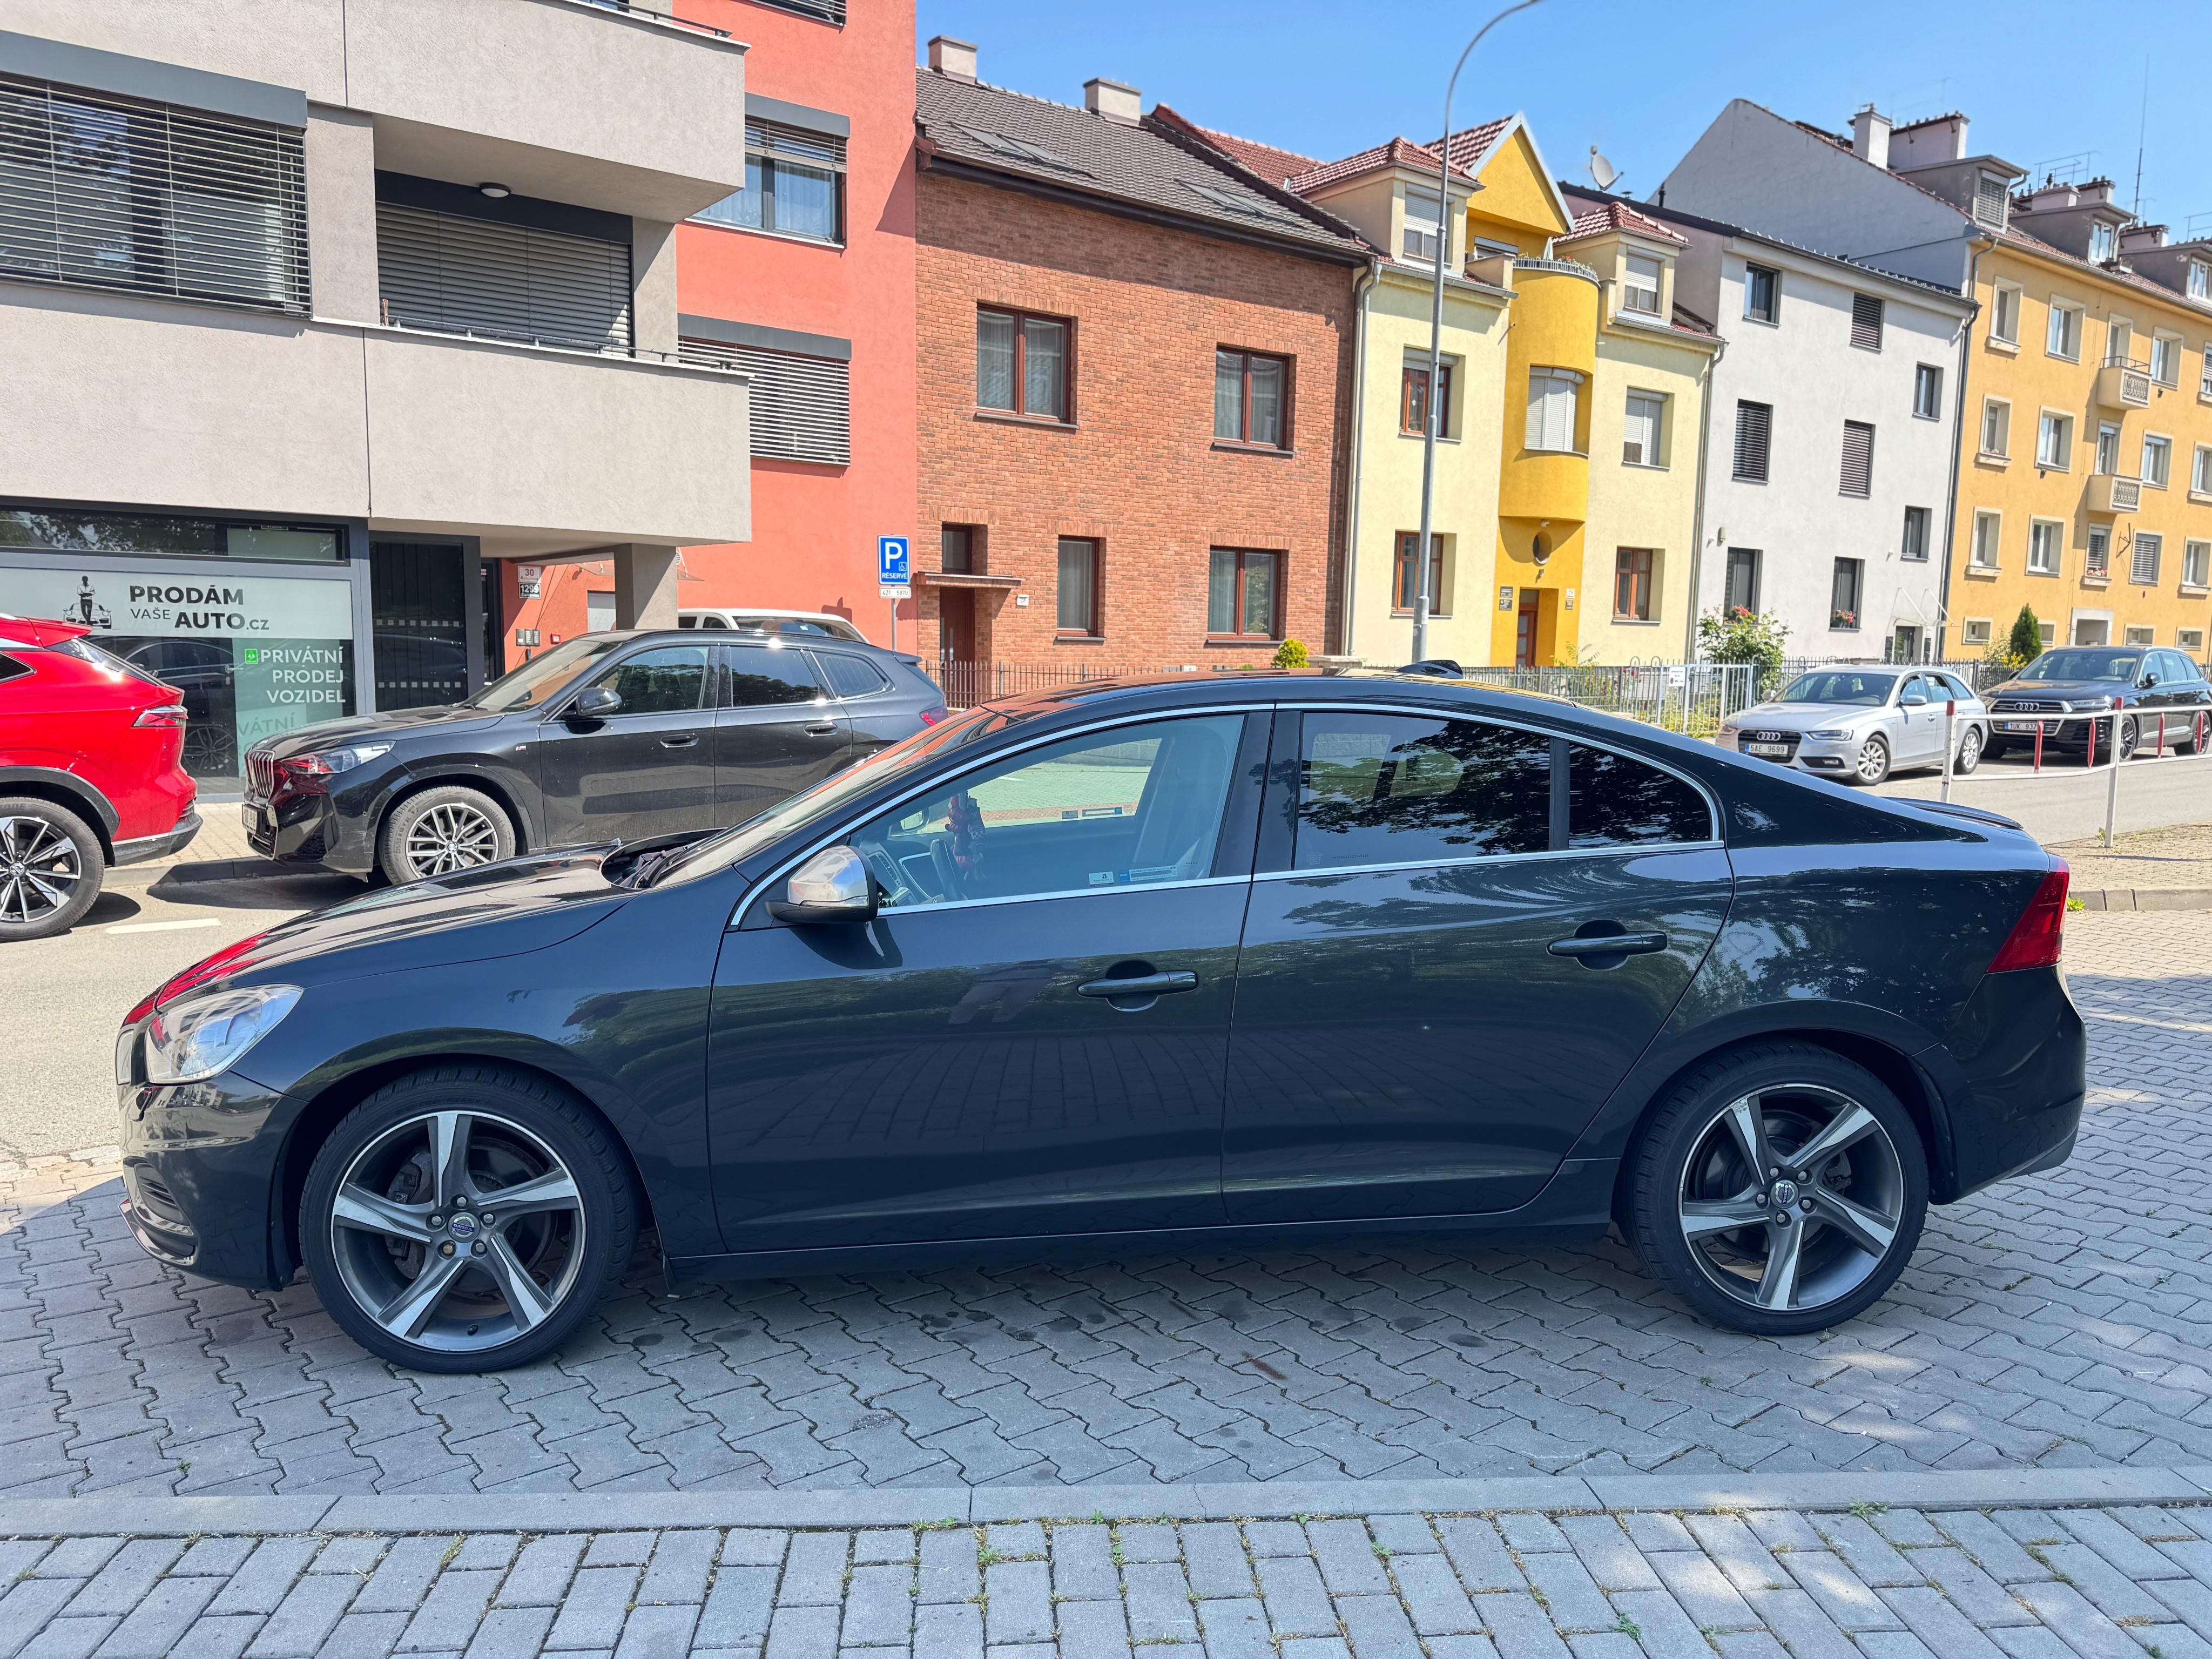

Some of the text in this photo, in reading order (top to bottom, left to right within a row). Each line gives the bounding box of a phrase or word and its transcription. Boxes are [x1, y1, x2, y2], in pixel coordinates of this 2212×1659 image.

[885, 542, 902, 569] P
[881, 571, 907, 579] RÉSERVÉ
[129, 585, 244, 605] PRODÁM
[520, 584, 539, 594] 1299
[130, 607, 171, 620] VAŠE
[260, 646, 343, 663] PRIVÁTNÍ
[272, 670, 343, 683] PRODEJ
[266, 689, 346, 703] VOZIDEL
[1750, 744, 1785, 753] 5AE 9699
[453, 1223, 474, 1232] VOLVO
